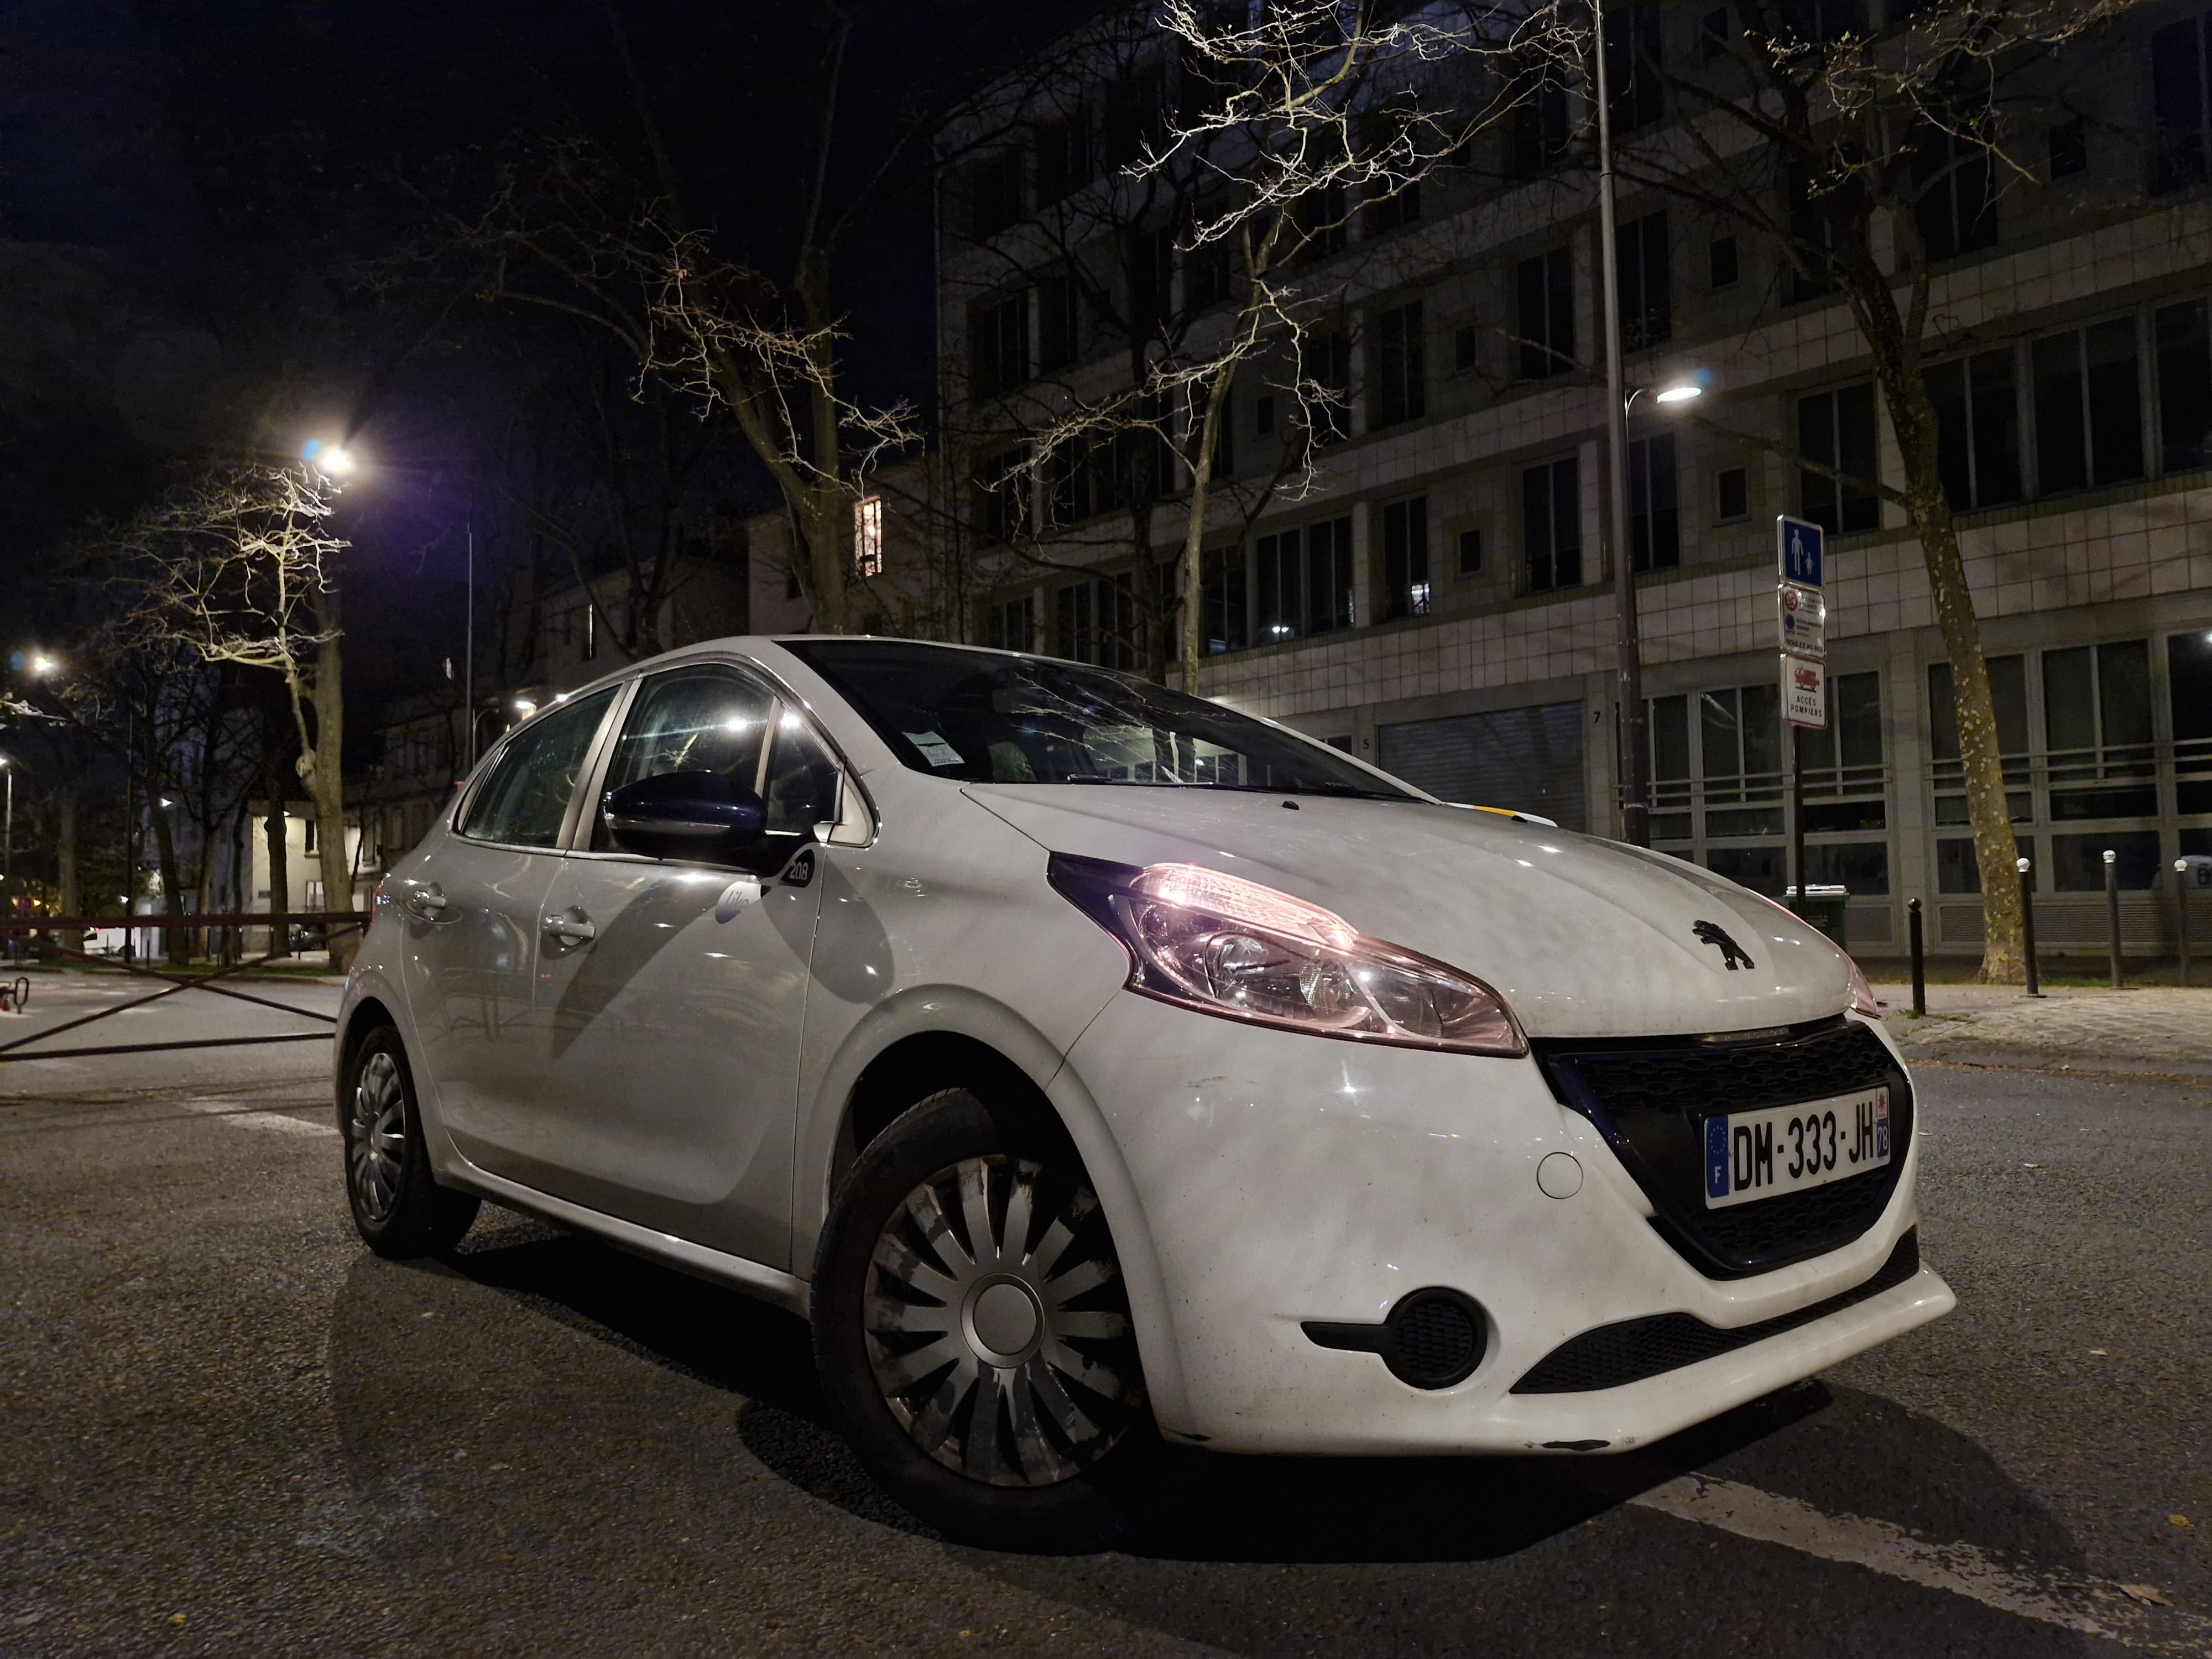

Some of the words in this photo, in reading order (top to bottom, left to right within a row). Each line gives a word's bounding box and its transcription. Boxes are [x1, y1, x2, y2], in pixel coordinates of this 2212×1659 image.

[1791, 703, 1822, 717] POMPIERS
[1593, 711, 1601, 724] 7
[1363, 738, 1369, 749] 5
[789, 860, 808, 880] 208
[1714, 1165, 1721, 1185] F
[1733, 1101, 1874, 1192] DM-333-JH
[1877, 1125, 1888, 1152] 78
